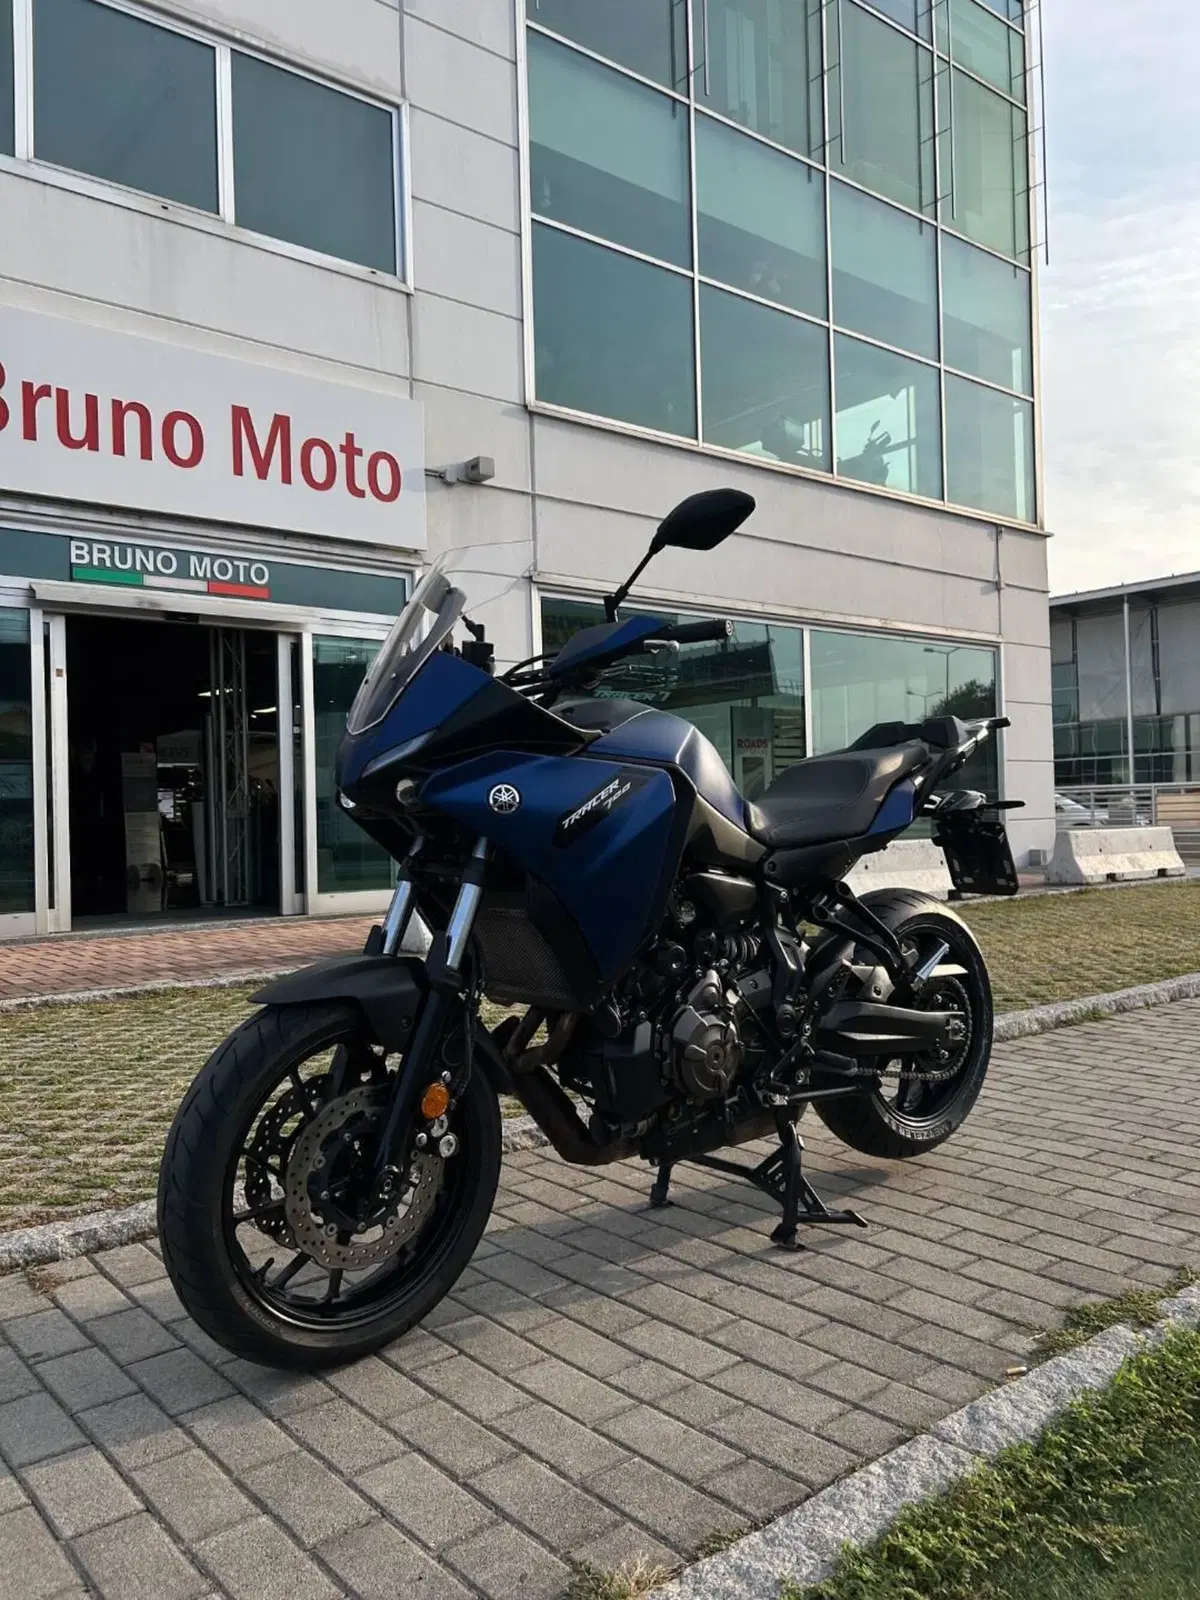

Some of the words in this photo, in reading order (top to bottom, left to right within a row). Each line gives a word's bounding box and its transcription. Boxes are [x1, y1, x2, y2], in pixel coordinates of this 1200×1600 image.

[0, 360, 204, 469] runo
[231, 404, 402, 503] Moto
[70, 540, 178, 575] BRUNO
[189, 555, 270, 586] MOTO
[736, 737, 769, 749] ROADS
[562, 778, 620, 829] TRACER
[603, 782, 631, 809] 700
[898, 1121, 950, 1140] METZELER
